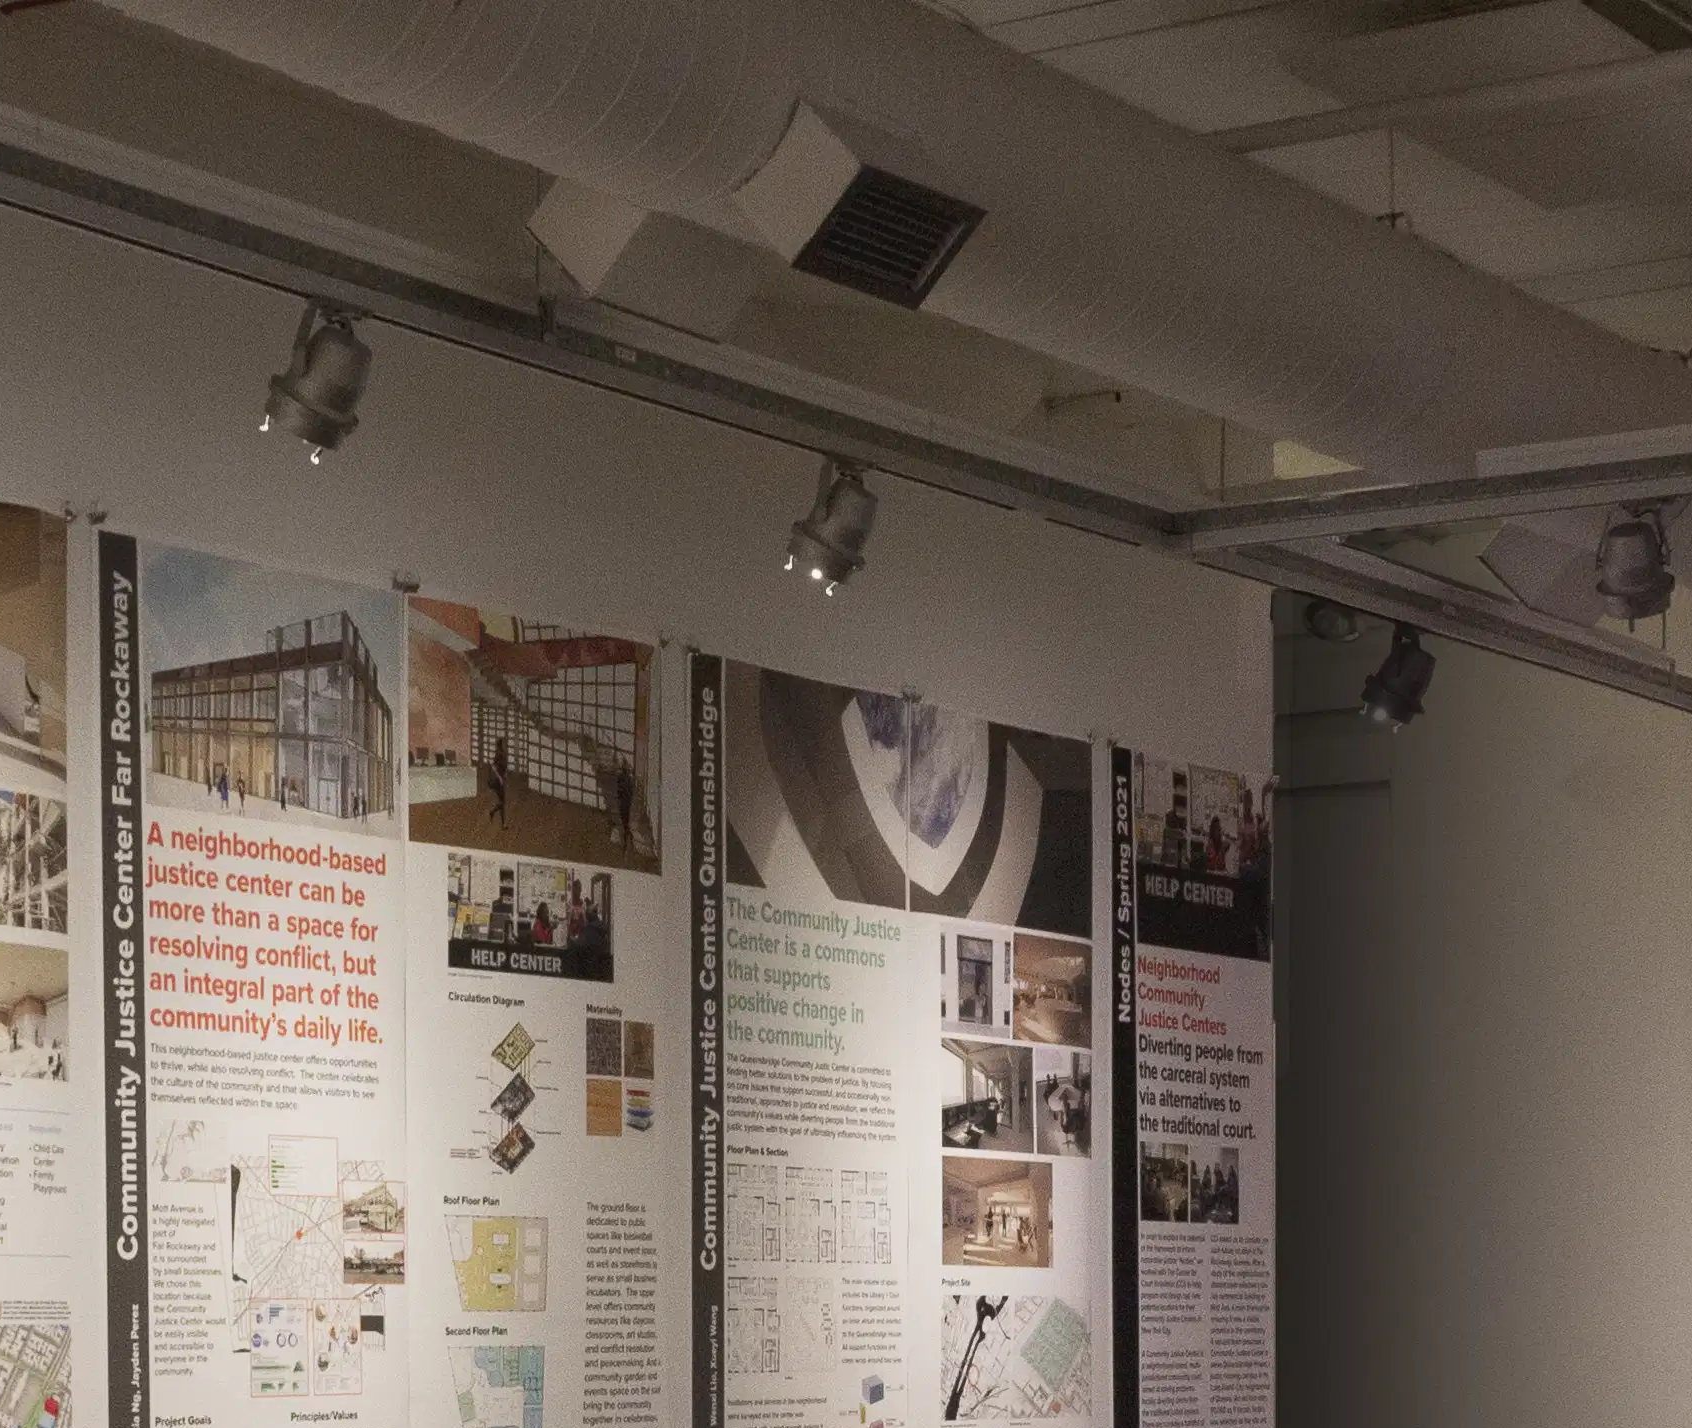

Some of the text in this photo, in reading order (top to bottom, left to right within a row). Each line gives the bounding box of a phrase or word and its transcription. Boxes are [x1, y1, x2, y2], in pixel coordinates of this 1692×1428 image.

[146, 820, 386, 876] A neighborhood-based
[144, 859, 365, 907] justice center can be
[1116, 775, 1131, 1023] Nodes / Spring 2021
[1145, 875, 1235, 908] HELP CENTER
[109, 571, 141, 1260] Community Justice Center Far Rockaway
[148, 899, 378, 942] more than a space for
[727, 895, 900, 941] The Community Justice
[149, 935, 376, 976] resolving conflict, but
[471, 948, 562, 973] HELP CENTER
[725, 925, 884, 968] Center is a commons
[697, 686, 720, 1270] Community Justice Center Queensbridge
[725, 957, 830, 991] that supports
[1137, 956, 1221, 985] Neighborhood
[149, 971, 379, 1010] an integral part of the
[1138, 982, 1207, 1012] Community
[149, 1007, 383, 1044] community’s daily life.
[726, 992, 864, 1027] positive change in
[1138, 1008, 1227, 1036] Justice Centers
[727, 1021, 845, 1055] the community.
[1138, 1032, 1263, 1064] Diverting people from
[1138, 1060, 1250, 1090] the carceral system
[1138, 1088, 1241, 1113] via alternatives to
[1139, 1113, 1256, 1139] the traditional court.
[154, 1415, 212, 1428] Project Goals
